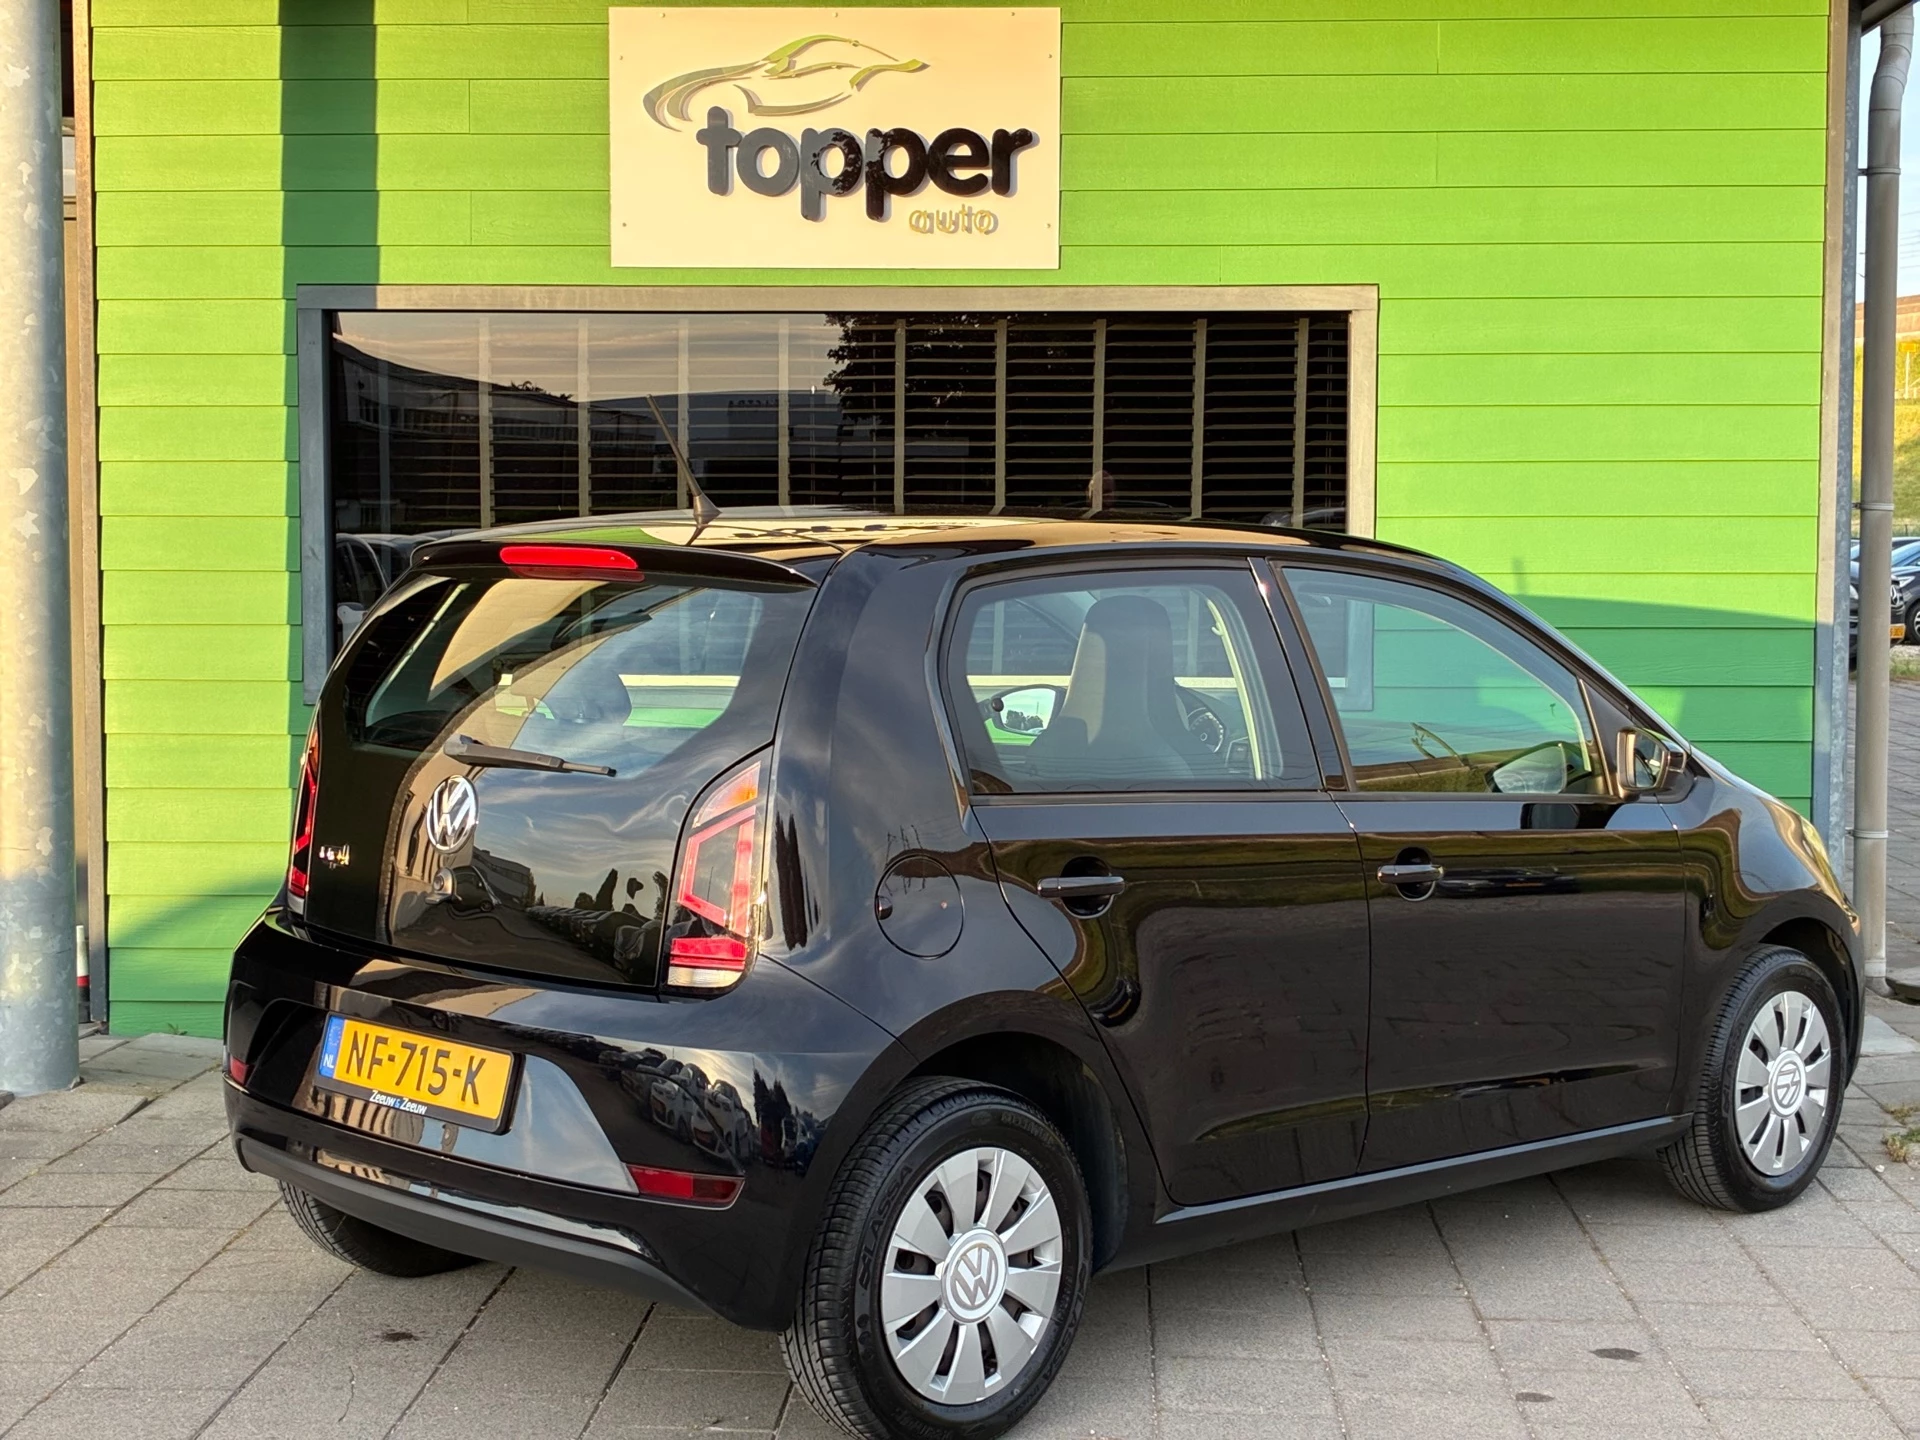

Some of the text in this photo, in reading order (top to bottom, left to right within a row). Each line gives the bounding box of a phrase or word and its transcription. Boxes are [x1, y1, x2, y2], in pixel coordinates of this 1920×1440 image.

[695, 106, 1034, 221] topper
[908, 203, 994, 234] auto
[323, 1052, 335, 1069] NL
[345, 1030, 487, 1105] NF-715-K
